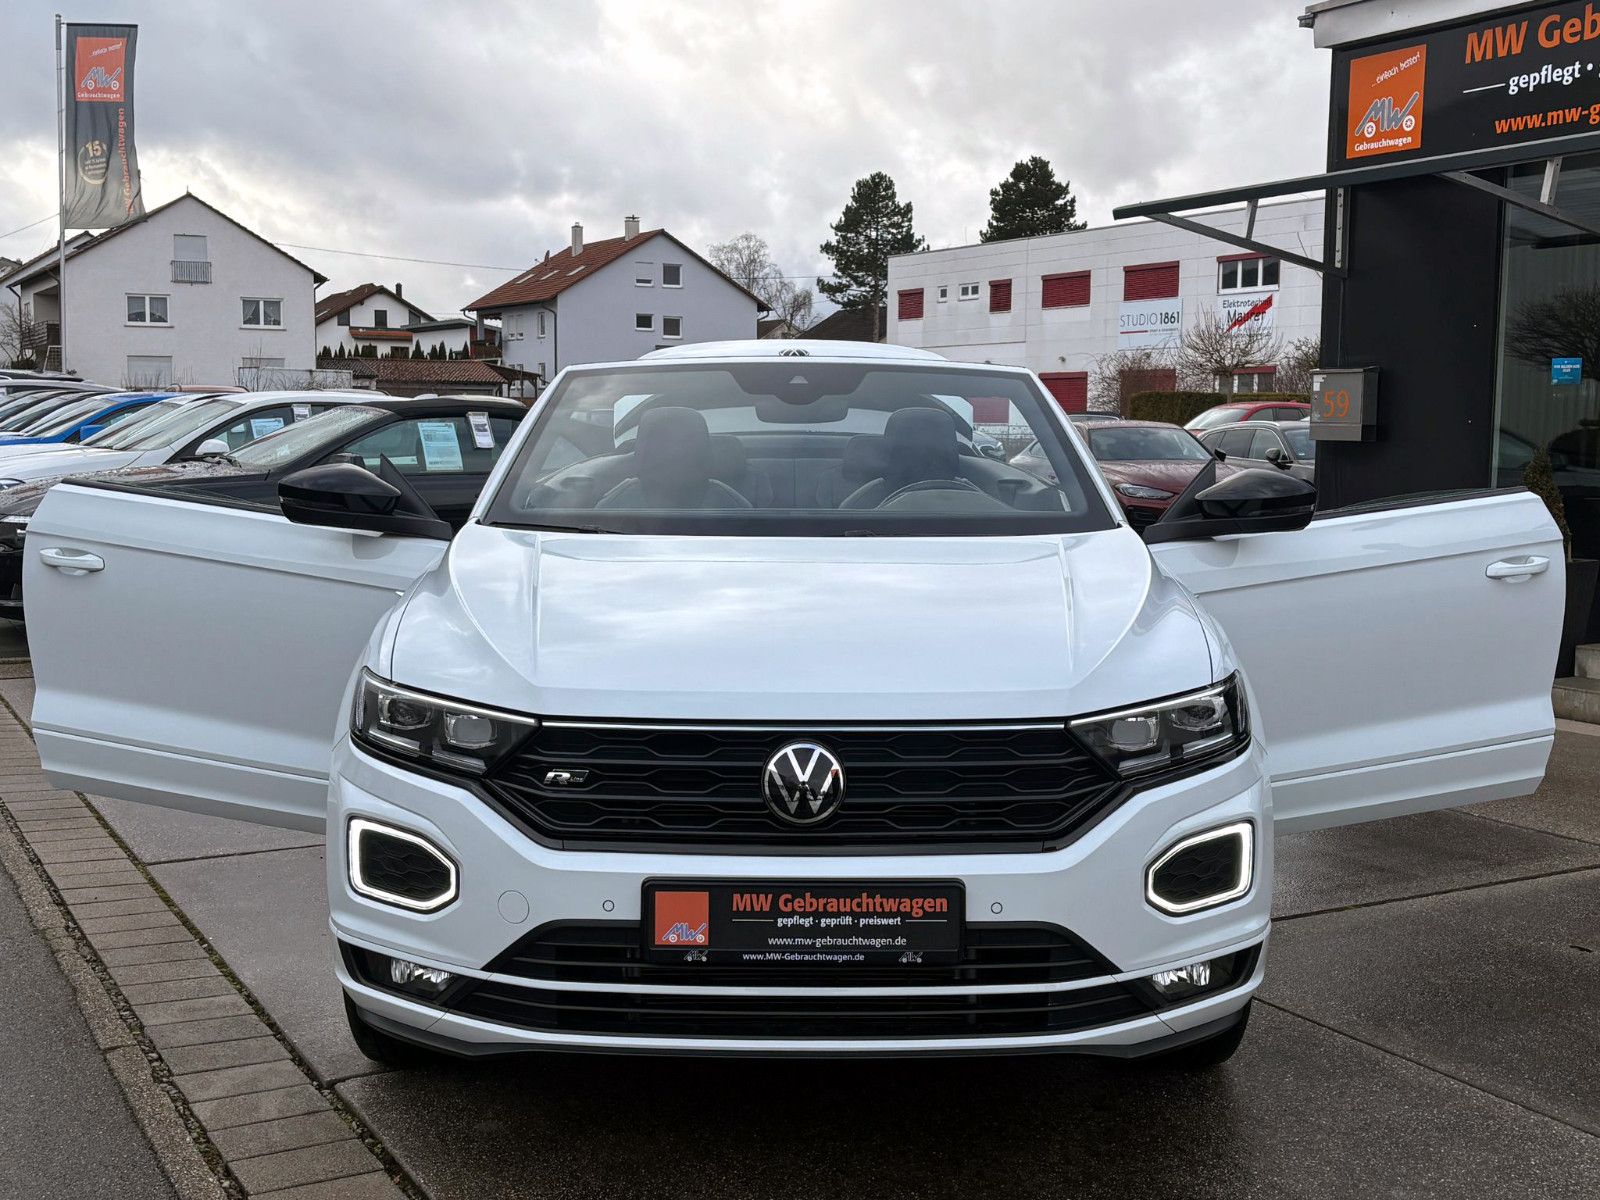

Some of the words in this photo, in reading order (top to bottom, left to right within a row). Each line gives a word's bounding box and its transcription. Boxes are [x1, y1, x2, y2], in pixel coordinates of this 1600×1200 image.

[1465, 20, 1528, 65] MW
[1508, 61, 1581, 95] gepflegt
[1354, 136, 1412, 152] Gebrauchtwagen
[1120, 312, 1158, 328] STUDIO
[1160, 311, 1180, 325] 1861
[1324, 389, 1350, 417] 59
[732, 893, 773, 912] MW
[778, 892, 948, 918] Gebrauchtwagen
[777, 915, 814, 927] gepflegt
[820, 915, 853, 927] geprüft
[860, 915, 901, 927] preiswert
[768, 936, 907, 948] www.mw-gebrauchtwagen.de
[742, 952, 865, 963] www.MW-Gebrauchtwagen.de
